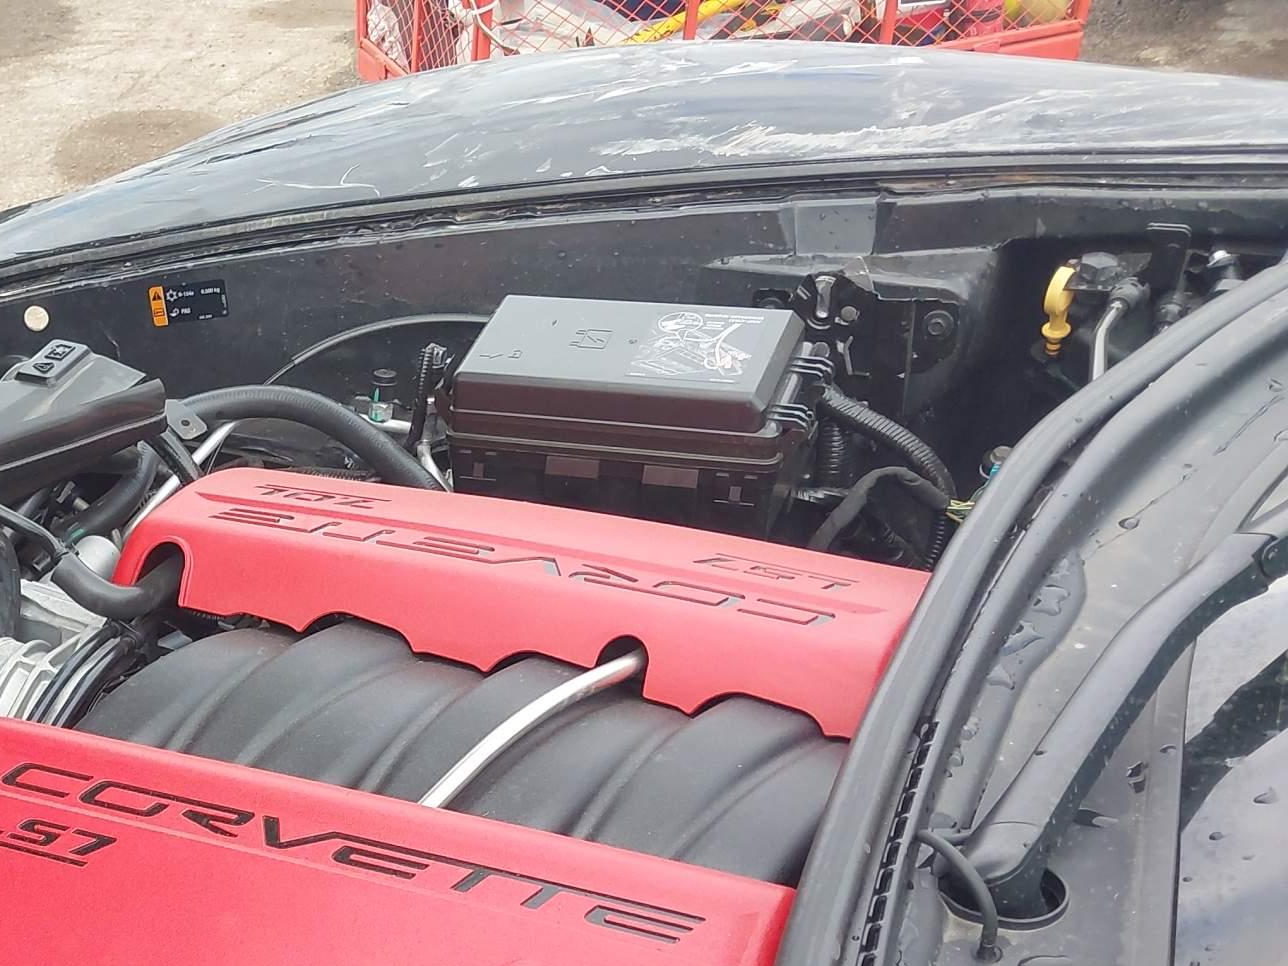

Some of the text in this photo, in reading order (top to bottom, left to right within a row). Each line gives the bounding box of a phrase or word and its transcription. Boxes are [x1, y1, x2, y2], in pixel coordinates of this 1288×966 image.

[208, 508, 835, 626] CORVETTE
[693, 556, 851, 592] LS7
[1, 762, 707, 944] CORVETTE
